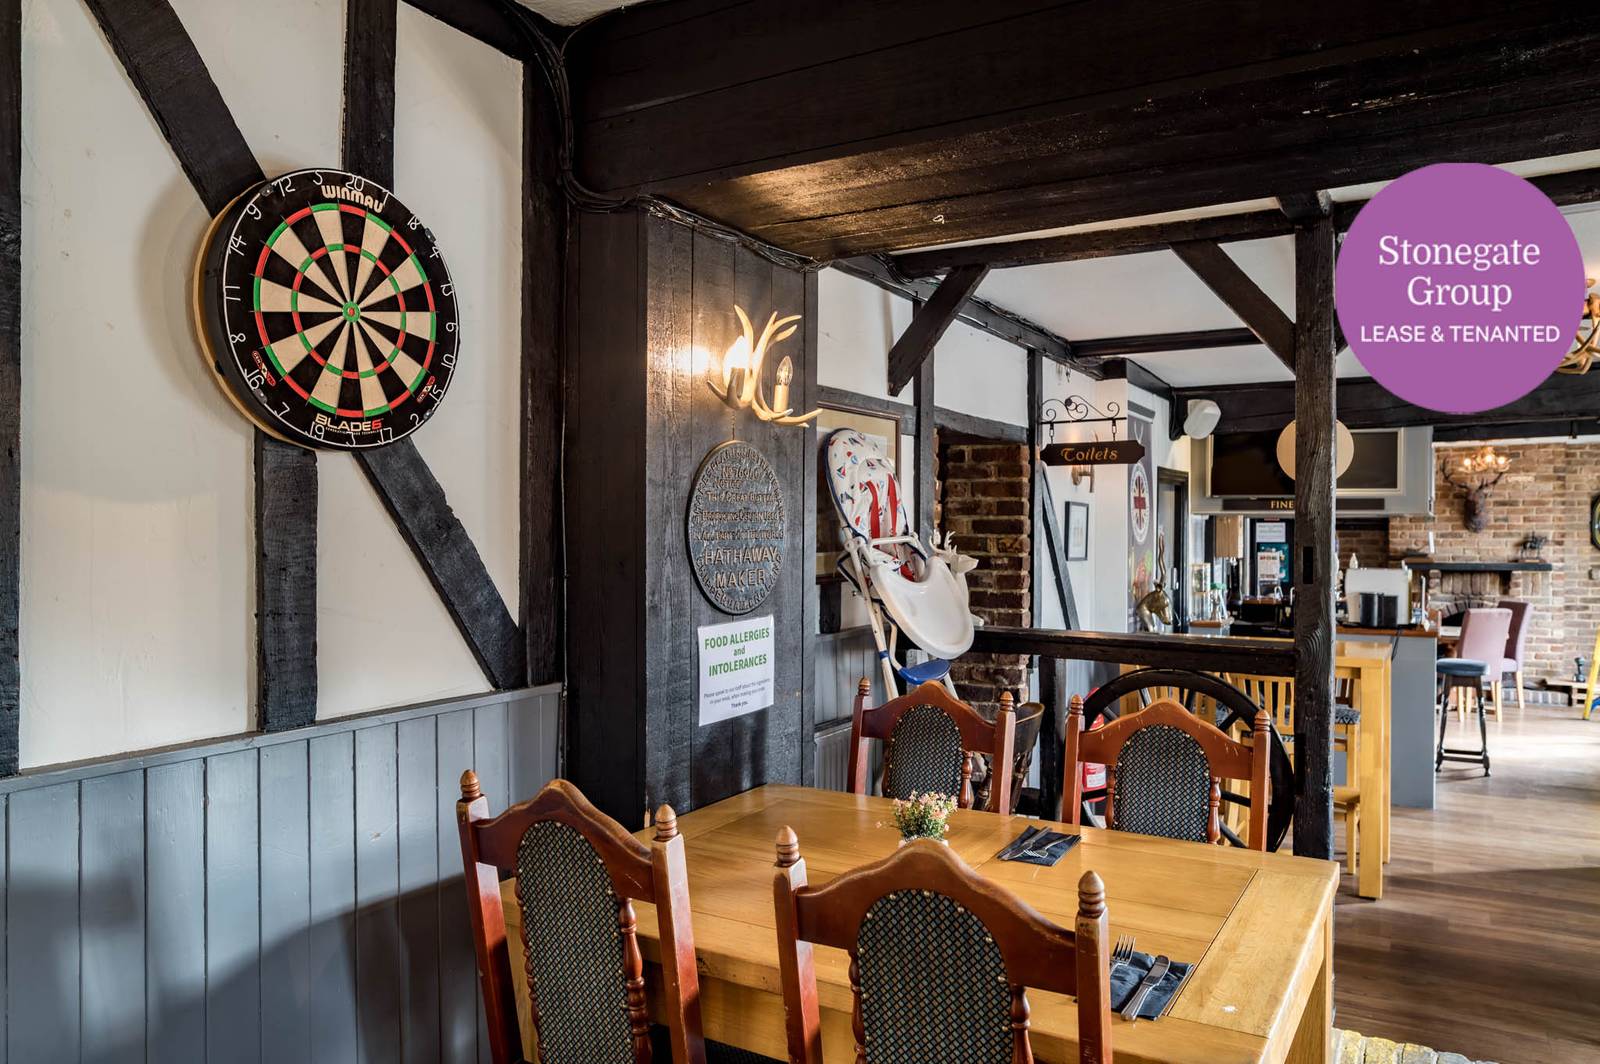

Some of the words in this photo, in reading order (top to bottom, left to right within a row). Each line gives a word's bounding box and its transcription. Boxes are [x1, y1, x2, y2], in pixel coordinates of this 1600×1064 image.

[313, 170, 323, 185] 5
[345, 174, 364, 192] 20
[274, 178, 296, 197] 12
[382, 189, 389, 205] 1
[245, 203, 262, 220] 9
[407, 218, 420, 231] 18
[229, 234, 246, 256] 14
[429, 245, 441, 259] 4
[224, 285, 241, 302] 11
[440, 283, 455, 297] 13
[446, 321, 458, 333] 6
[230, 331, 246, 344] 8
[440, 355, 455, 370] 10
[244, 368, 264, 389] 16
[429, 385, 443, 402] 15
[273, 401, 290, 418] 7
[410, 414, 423, 428] 2
[305, 421, 324, 440] 19
[346, 431, 356, 447] 3
[378, 427, 393, 445] 17
[1061, 447, 1119, 461] Toilets
[704, 548, 778, 566] HATHAWAY
[715, 569, 765, 590] MAKER
[705, 636, 728, 650] FOOD
[729, 628, 770, 644] ALLERGIES
[733, 645, 746, 657] and
[709, 654, 768, 677] INTOLERANCES
